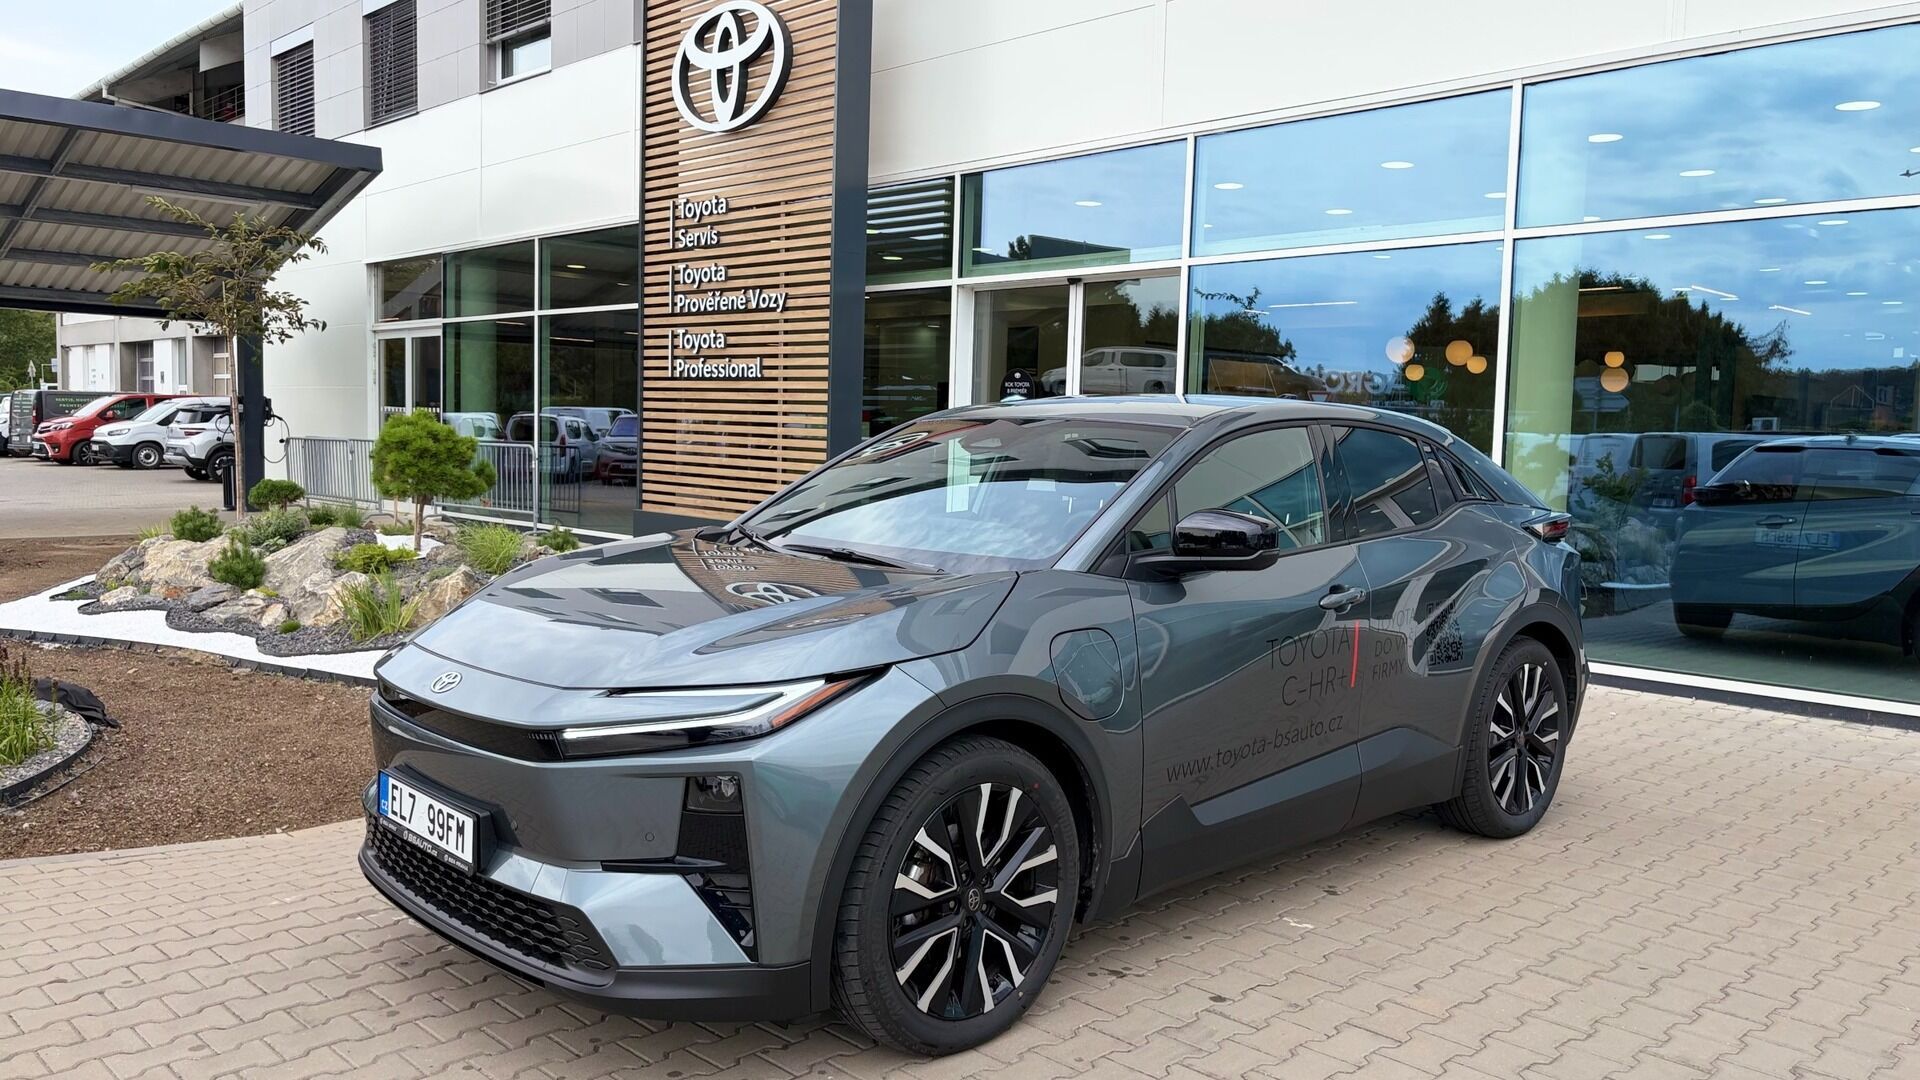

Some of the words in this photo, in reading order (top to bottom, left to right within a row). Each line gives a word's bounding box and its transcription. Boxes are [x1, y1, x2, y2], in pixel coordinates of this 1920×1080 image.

[679, 196, 727, 222] Toyota
[678, 226, 718, 248] Servis
[678, 263, 726, 289] Toyota
[676, 290, 746, 313] Prověřené
[749, 289, 786, 312] Vozy
[677, 329, 726, 354] Toyota
[676, 357, 762, 378] Professional
[1266, 624, 1350, 670] TOYOTA
[1374, 636, 1393, 658] DO
[1372, 659, 1405, 681] FIRMY
[1282, 666, 1348, 706] C-HR+
[1166, 715, 1344, 783] www.toyota-bsauto.cz
[381, 799, 388, 811] CZ
[391, 783, 416, 825] EL7
[427, 803, 465, 855] 99FM
